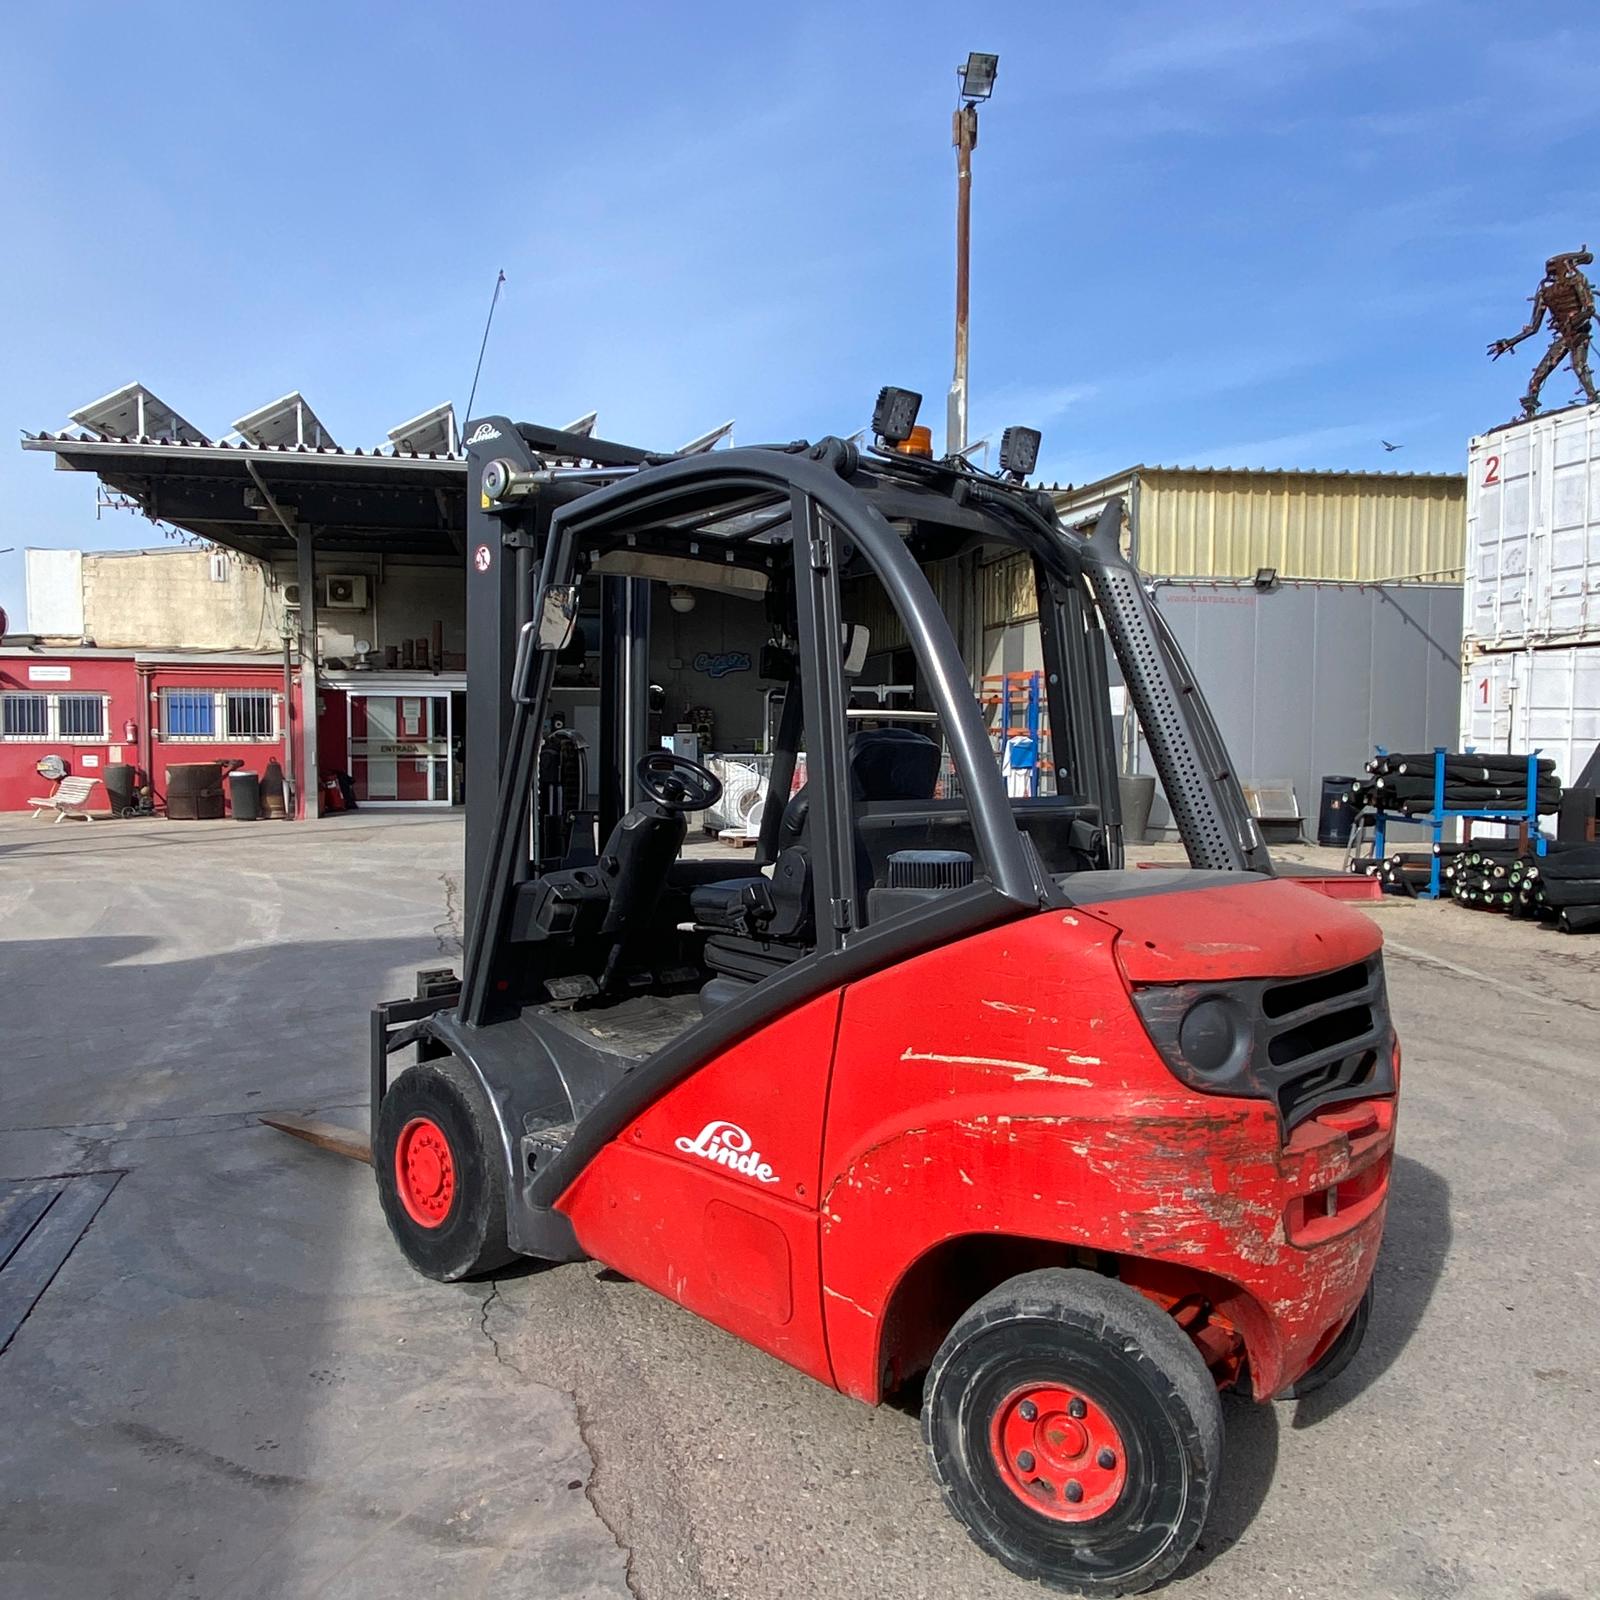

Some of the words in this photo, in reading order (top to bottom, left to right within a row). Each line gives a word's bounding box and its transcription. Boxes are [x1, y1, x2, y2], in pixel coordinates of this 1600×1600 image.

[466, 423, 502, 445] Linde
[1485, 456, 1500, 483] 2
[1480, 678, 1488, 704] 1
[380, 745, 419, 753] ENTRADA
[674, 1120, 780, 1183] Linde
